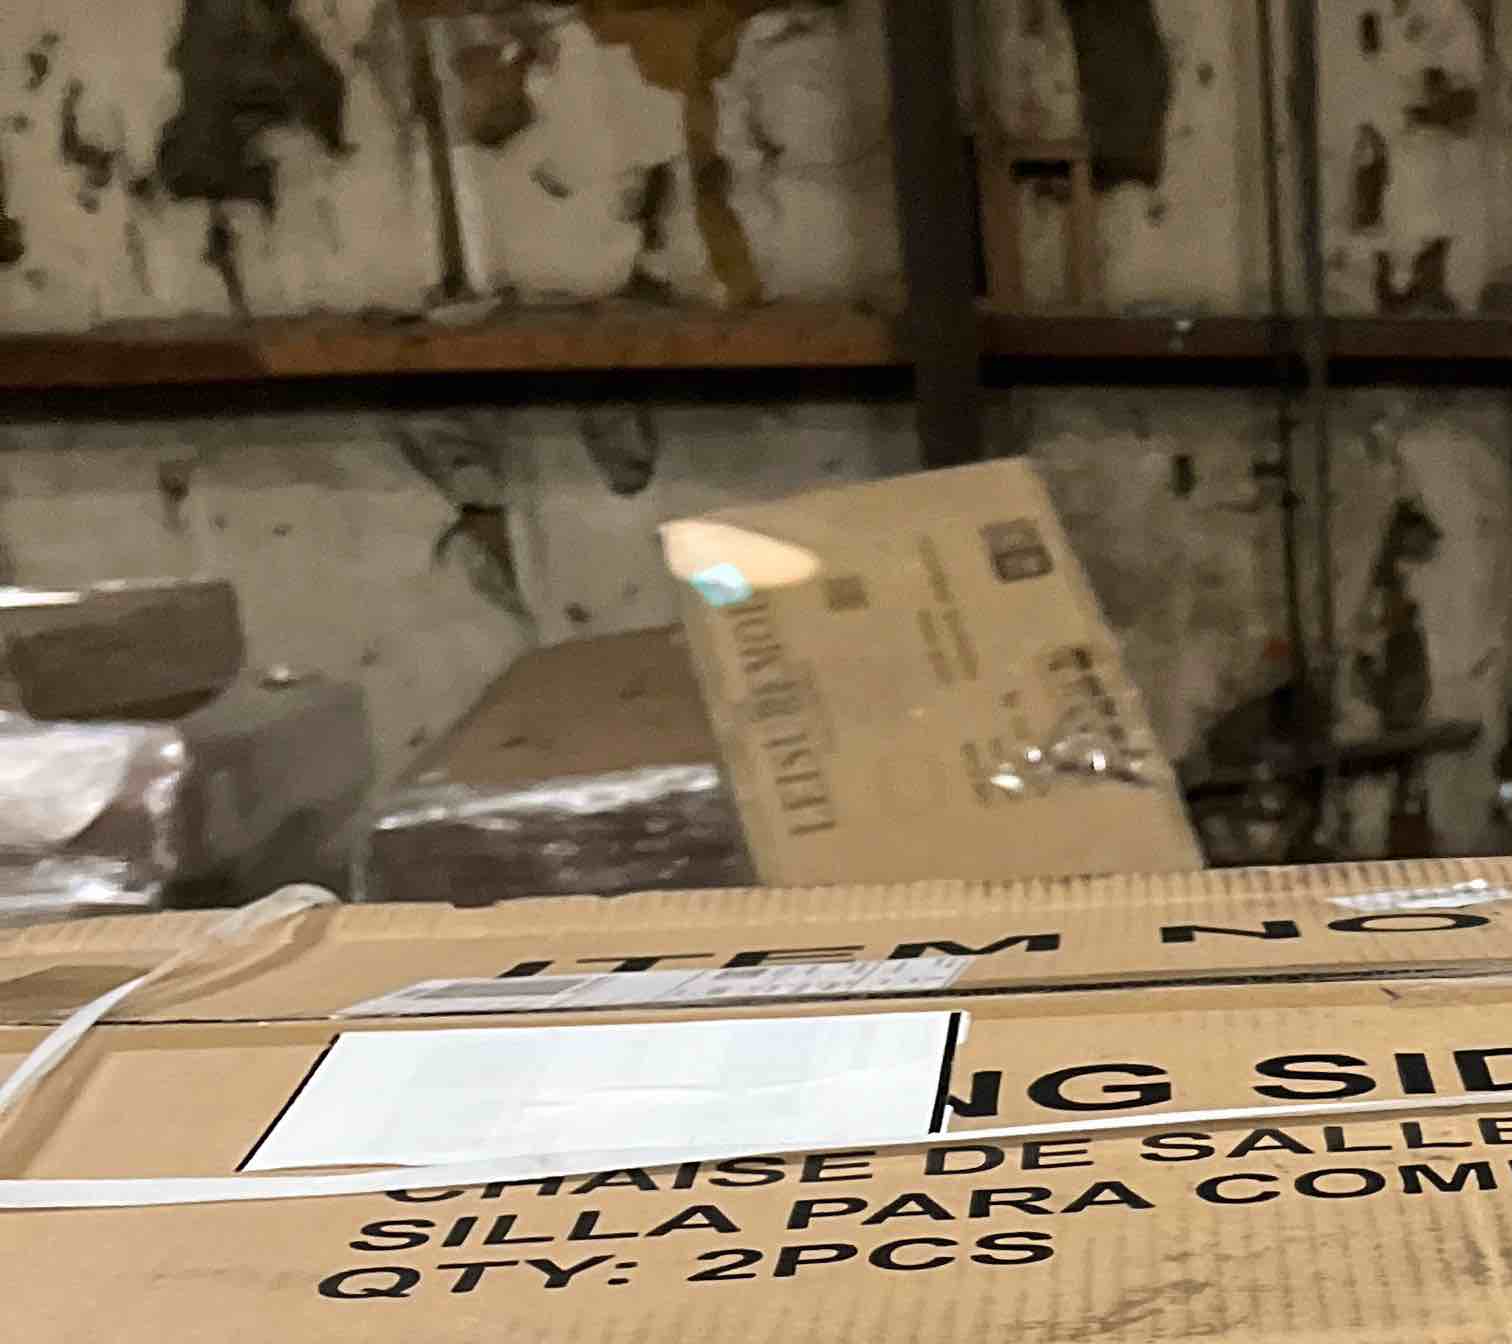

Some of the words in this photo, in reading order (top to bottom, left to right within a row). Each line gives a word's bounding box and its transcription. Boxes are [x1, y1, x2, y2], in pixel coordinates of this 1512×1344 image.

[924, 1137, 1095, 1176] DE
[349, 1203, 742, 1252] SILLA
[786, 1179, 1151, 1230] PARA
[318, 1254, 639, 1300] QTY:
[687, 1229, 1057, 1282] 2PCS
